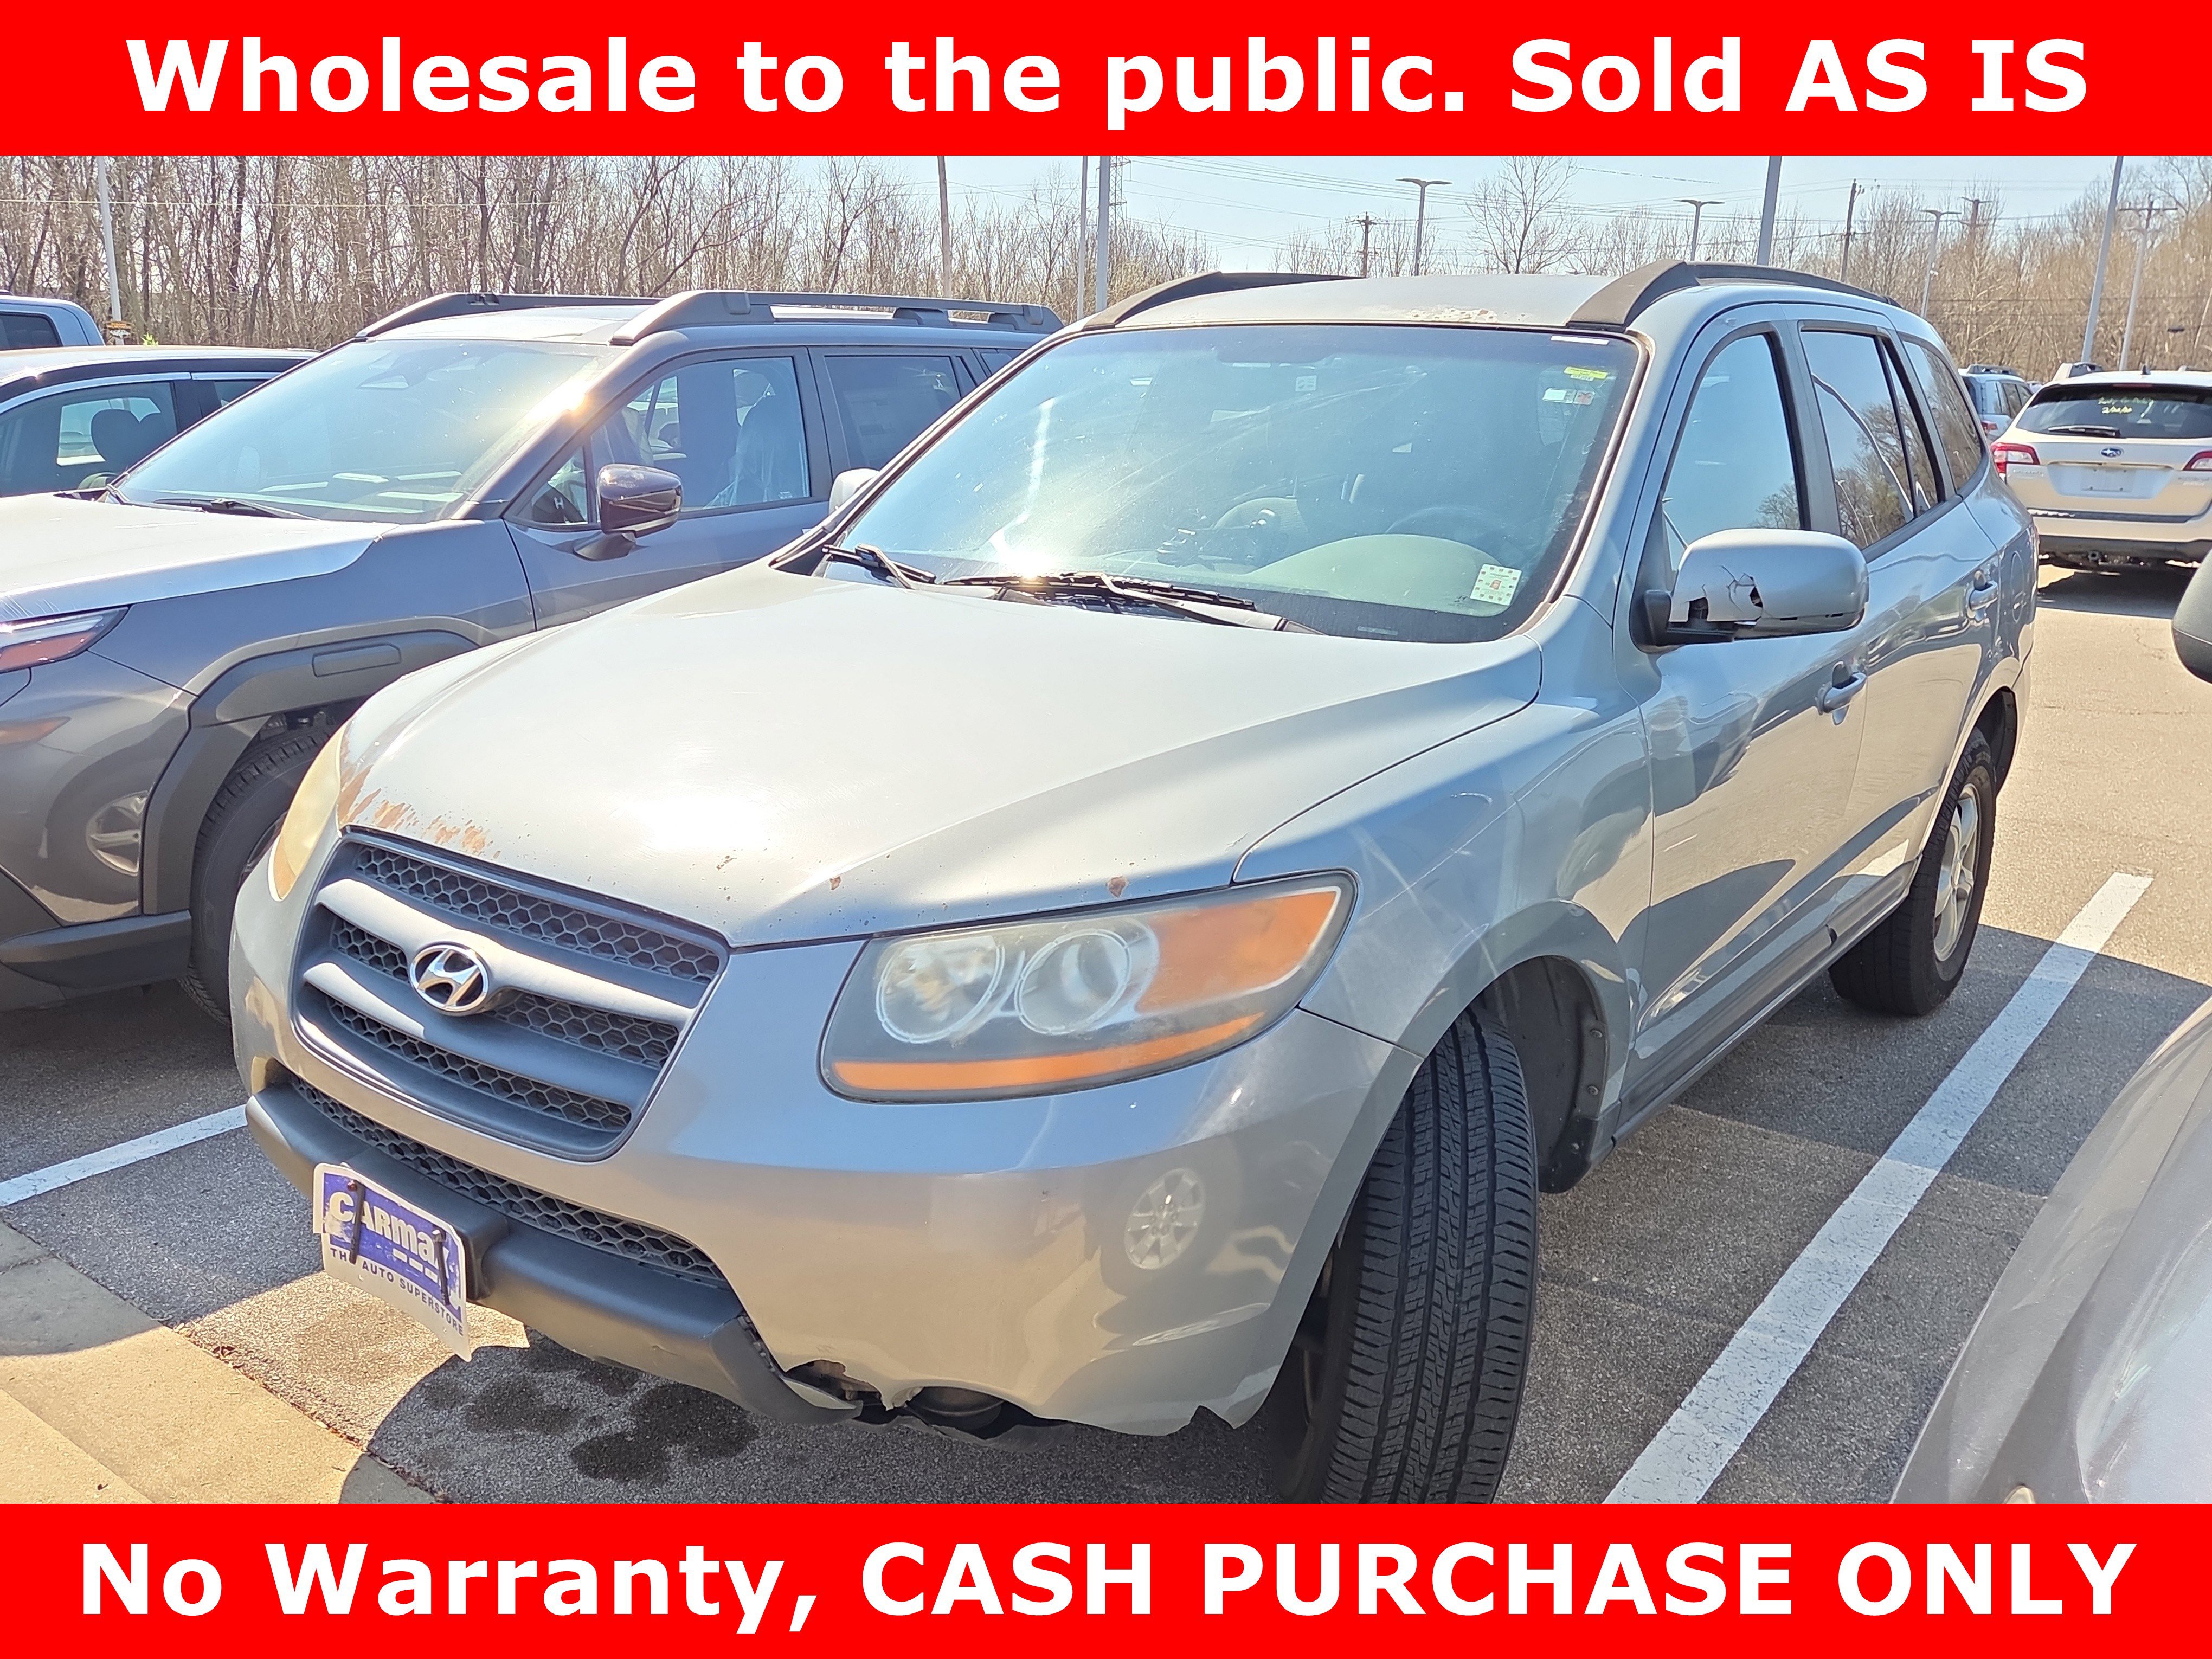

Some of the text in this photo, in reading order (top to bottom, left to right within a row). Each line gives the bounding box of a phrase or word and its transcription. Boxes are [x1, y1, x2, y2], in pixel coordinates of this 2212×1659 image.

[330, 1247, 464, 1336] TH AUTO SUPERSTORE
